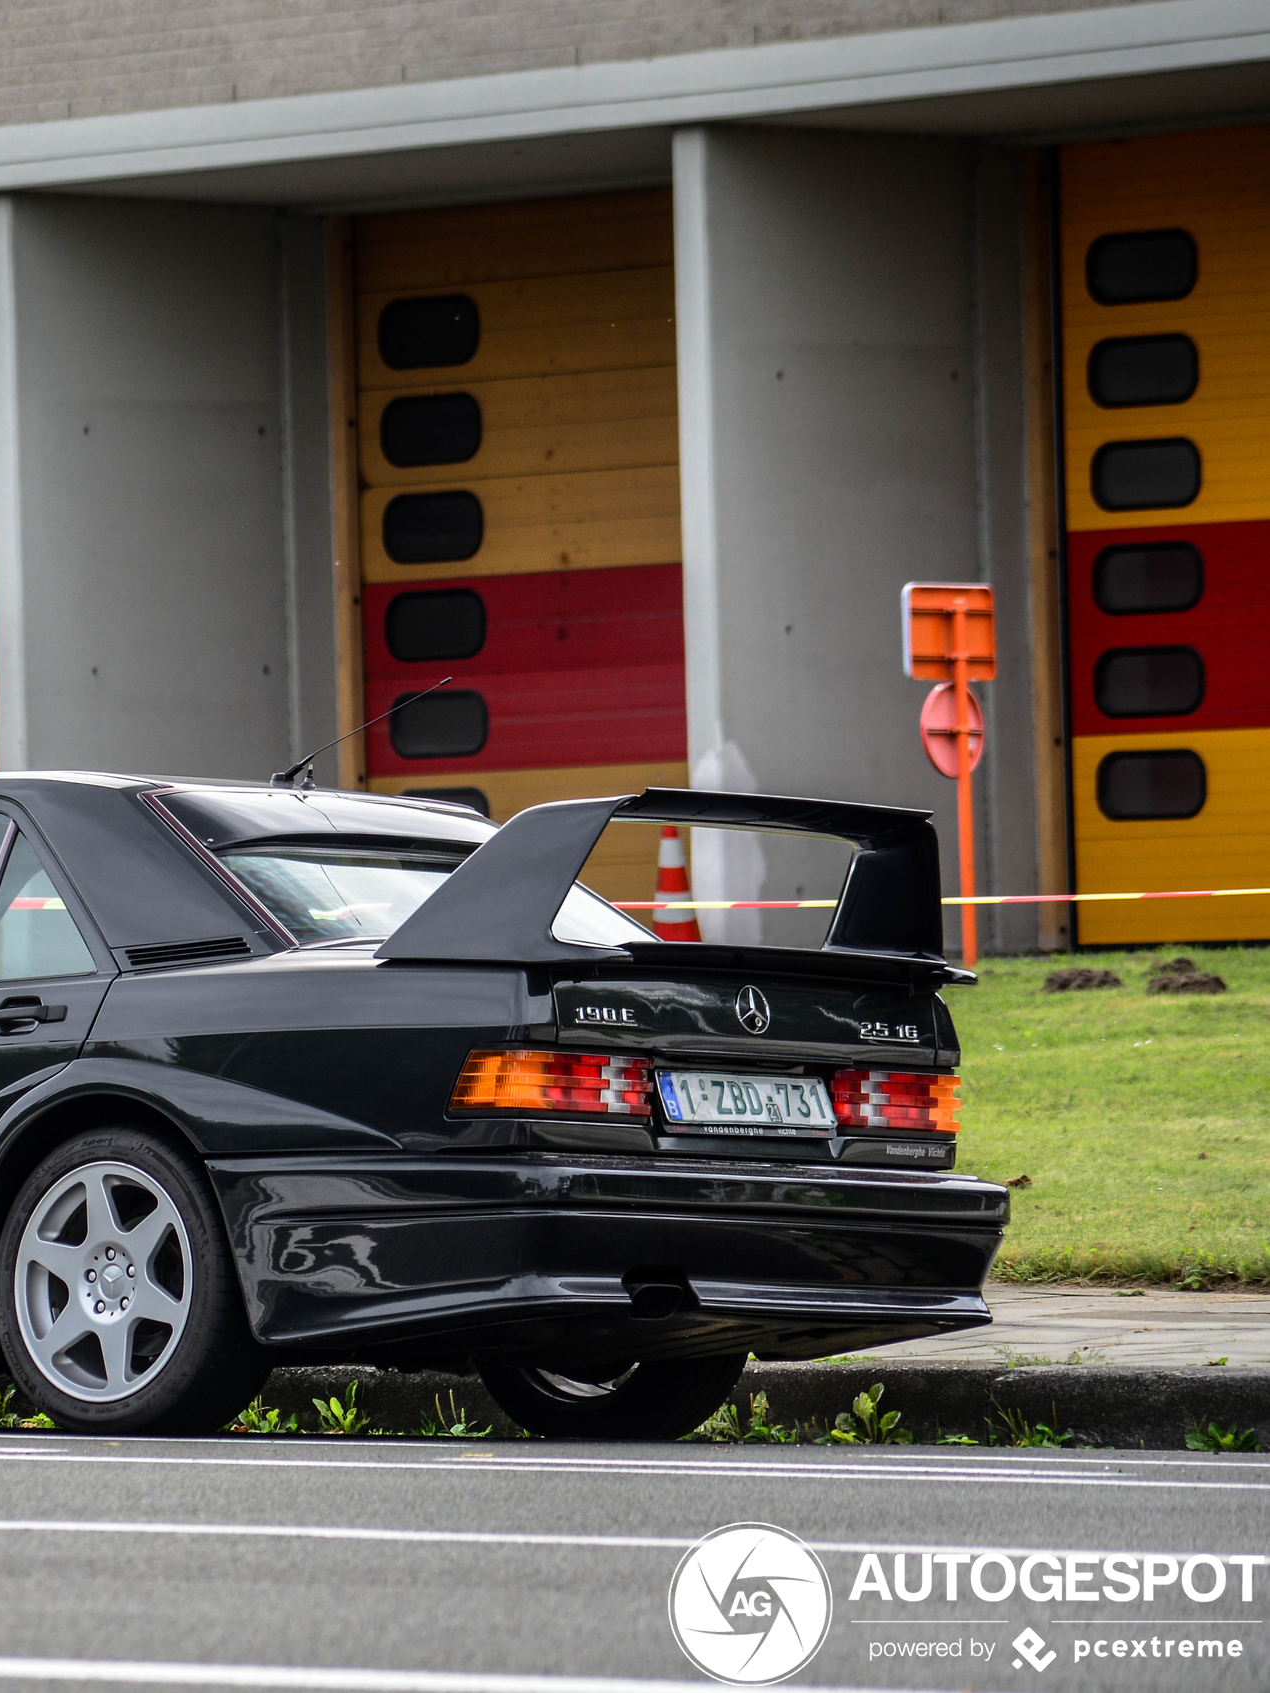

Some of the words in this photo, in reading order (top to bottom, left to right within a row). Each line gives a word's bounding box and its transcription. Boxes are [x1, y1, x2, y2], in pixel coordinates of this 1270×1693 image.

[576, 1006, 617, 1021] 190
[621, 1007, 636, 1023] E
[894, 1024, 918, 1039] 16
[667, 1100, 679, 1116] B
